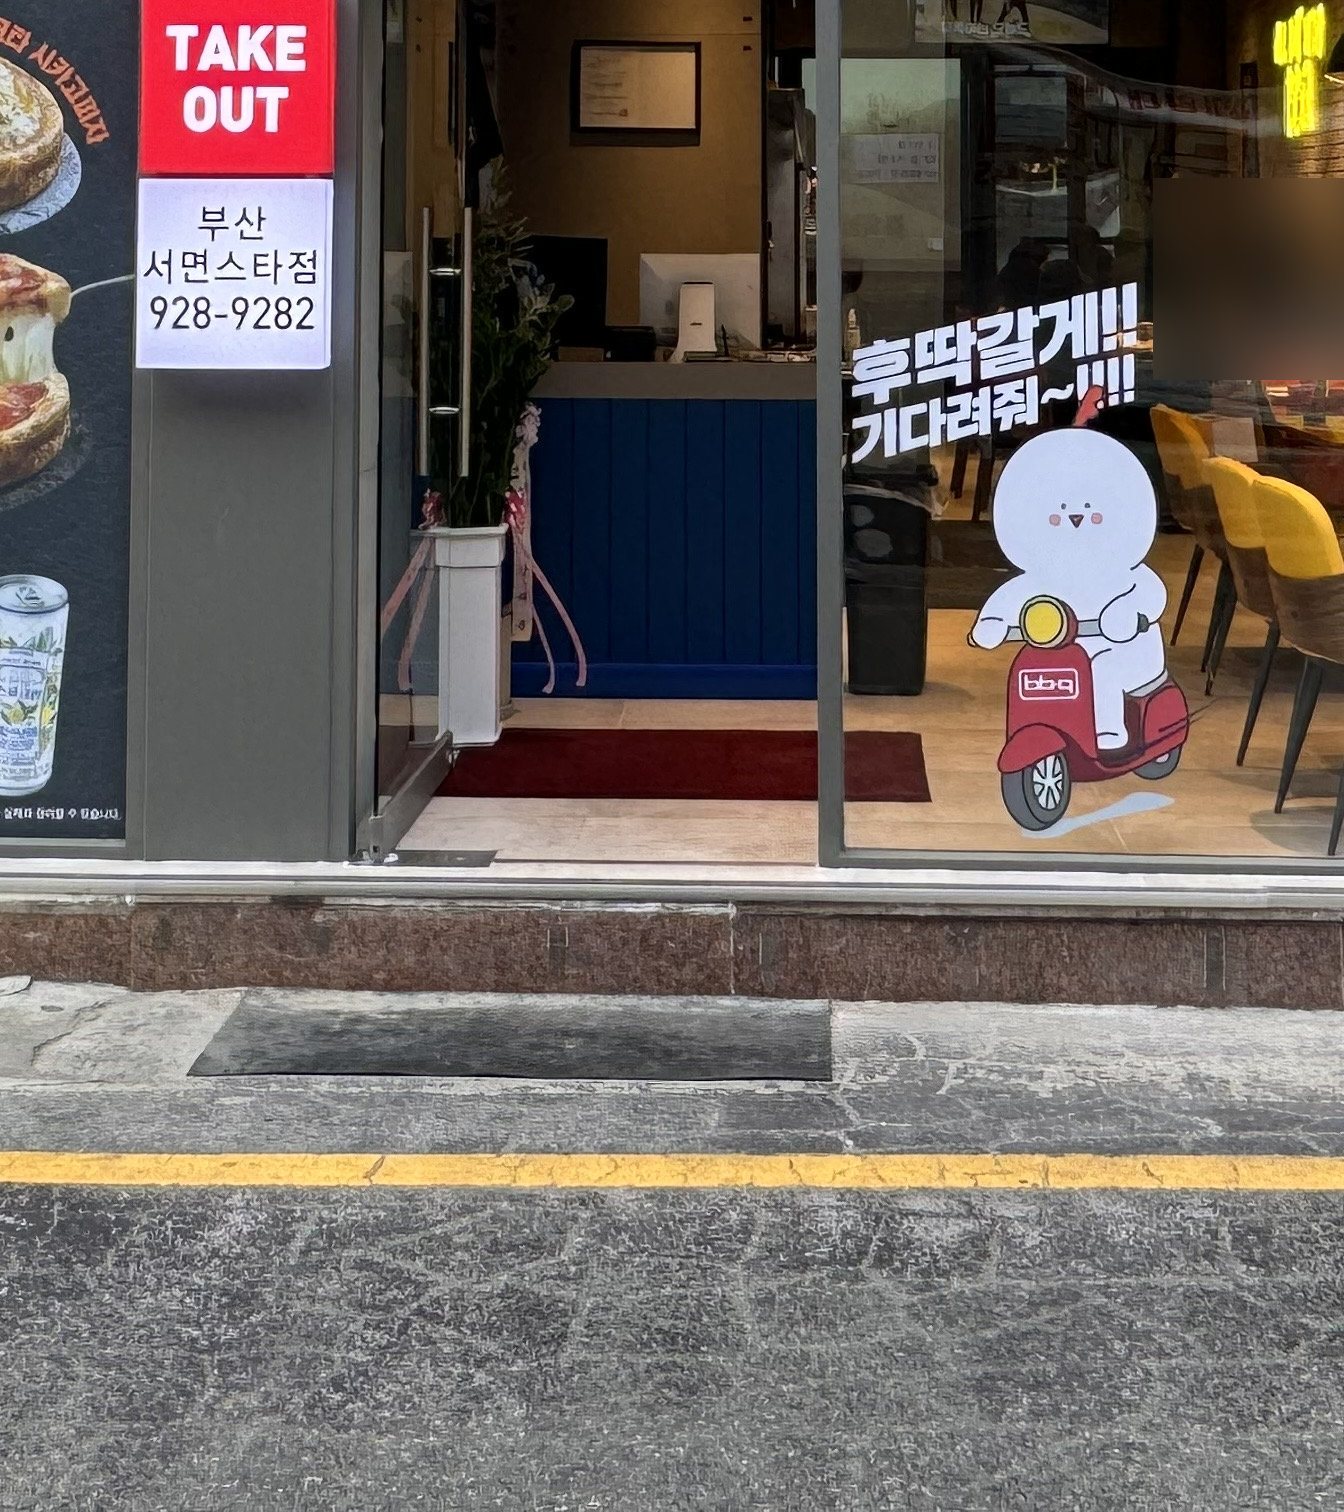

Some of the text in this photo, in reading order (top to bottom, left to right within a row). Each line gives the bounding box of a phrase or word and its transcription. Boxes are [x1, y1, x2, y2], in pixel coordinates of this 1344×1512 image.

[166, 25, 307, 72] TAKE
[28, 42, 110, 145] 시카고피자
[182, 86, 290, 133] OUT
[197, 206, 267, 242] 부산
[143, 248, 318, 286] 서면스타점
[149, 295, 316, 331] 928-9282
[852, 282, 1137, 405] 후딱갈게!!
